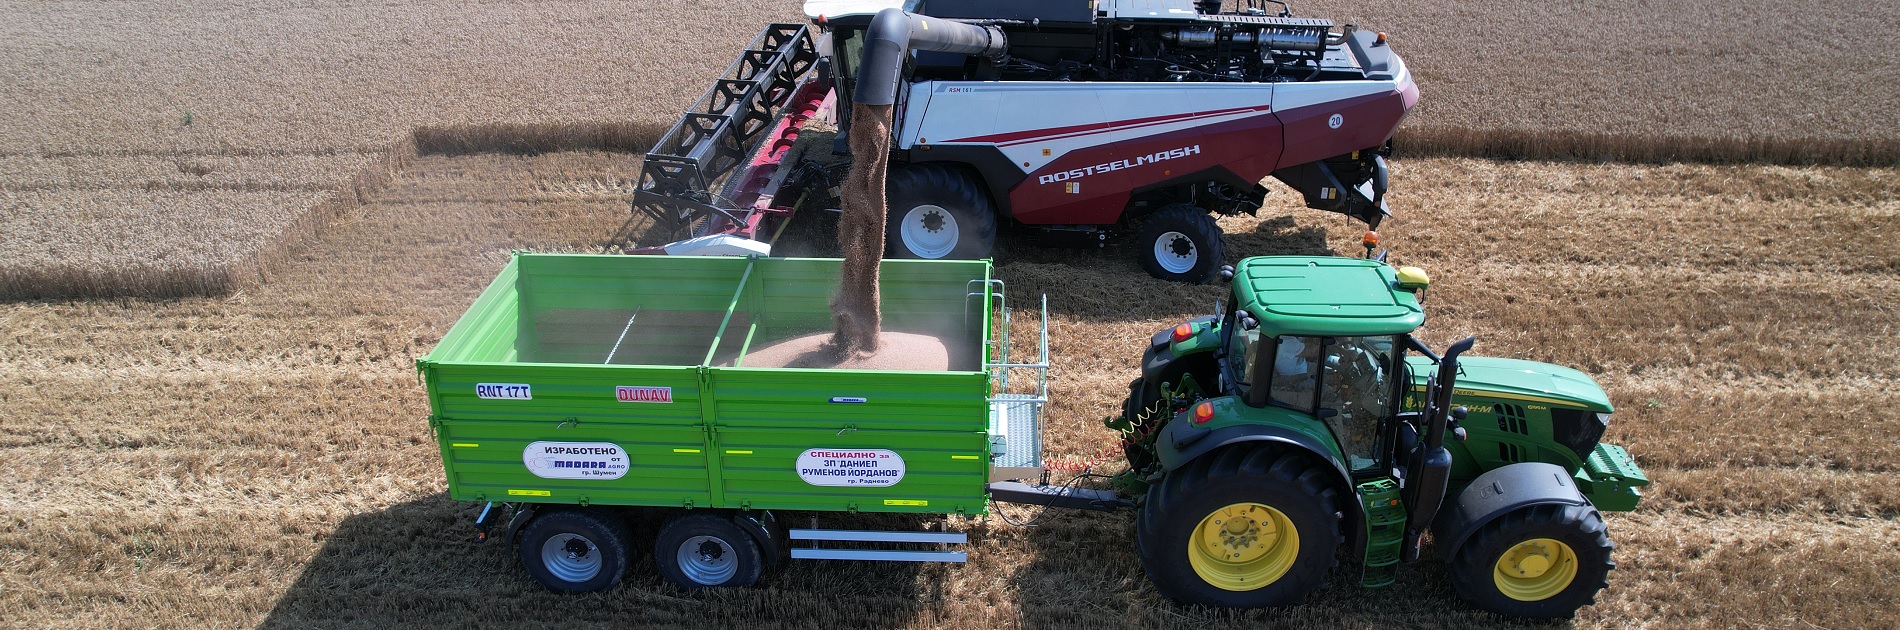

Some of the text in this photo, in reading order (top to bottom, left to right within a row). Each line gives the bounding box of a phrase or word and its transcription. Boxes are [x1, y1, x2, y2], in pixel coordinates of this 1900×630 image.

[1331, 116, 1341, 126] 20
[1038, 144, 1201, 185] ROSTSELMASH
[477, 385, 503, 398] RNT
[618, 388, 670, 402] DUNAV
[544, 446, 617, 455] ИЗРАБОТЕНО
[810, 451, 876, 459] СПЕЦИАЛНО
[554, 461, 607, 469] MADARA
[802, 468, 847, 476] РУМЕНОВ
